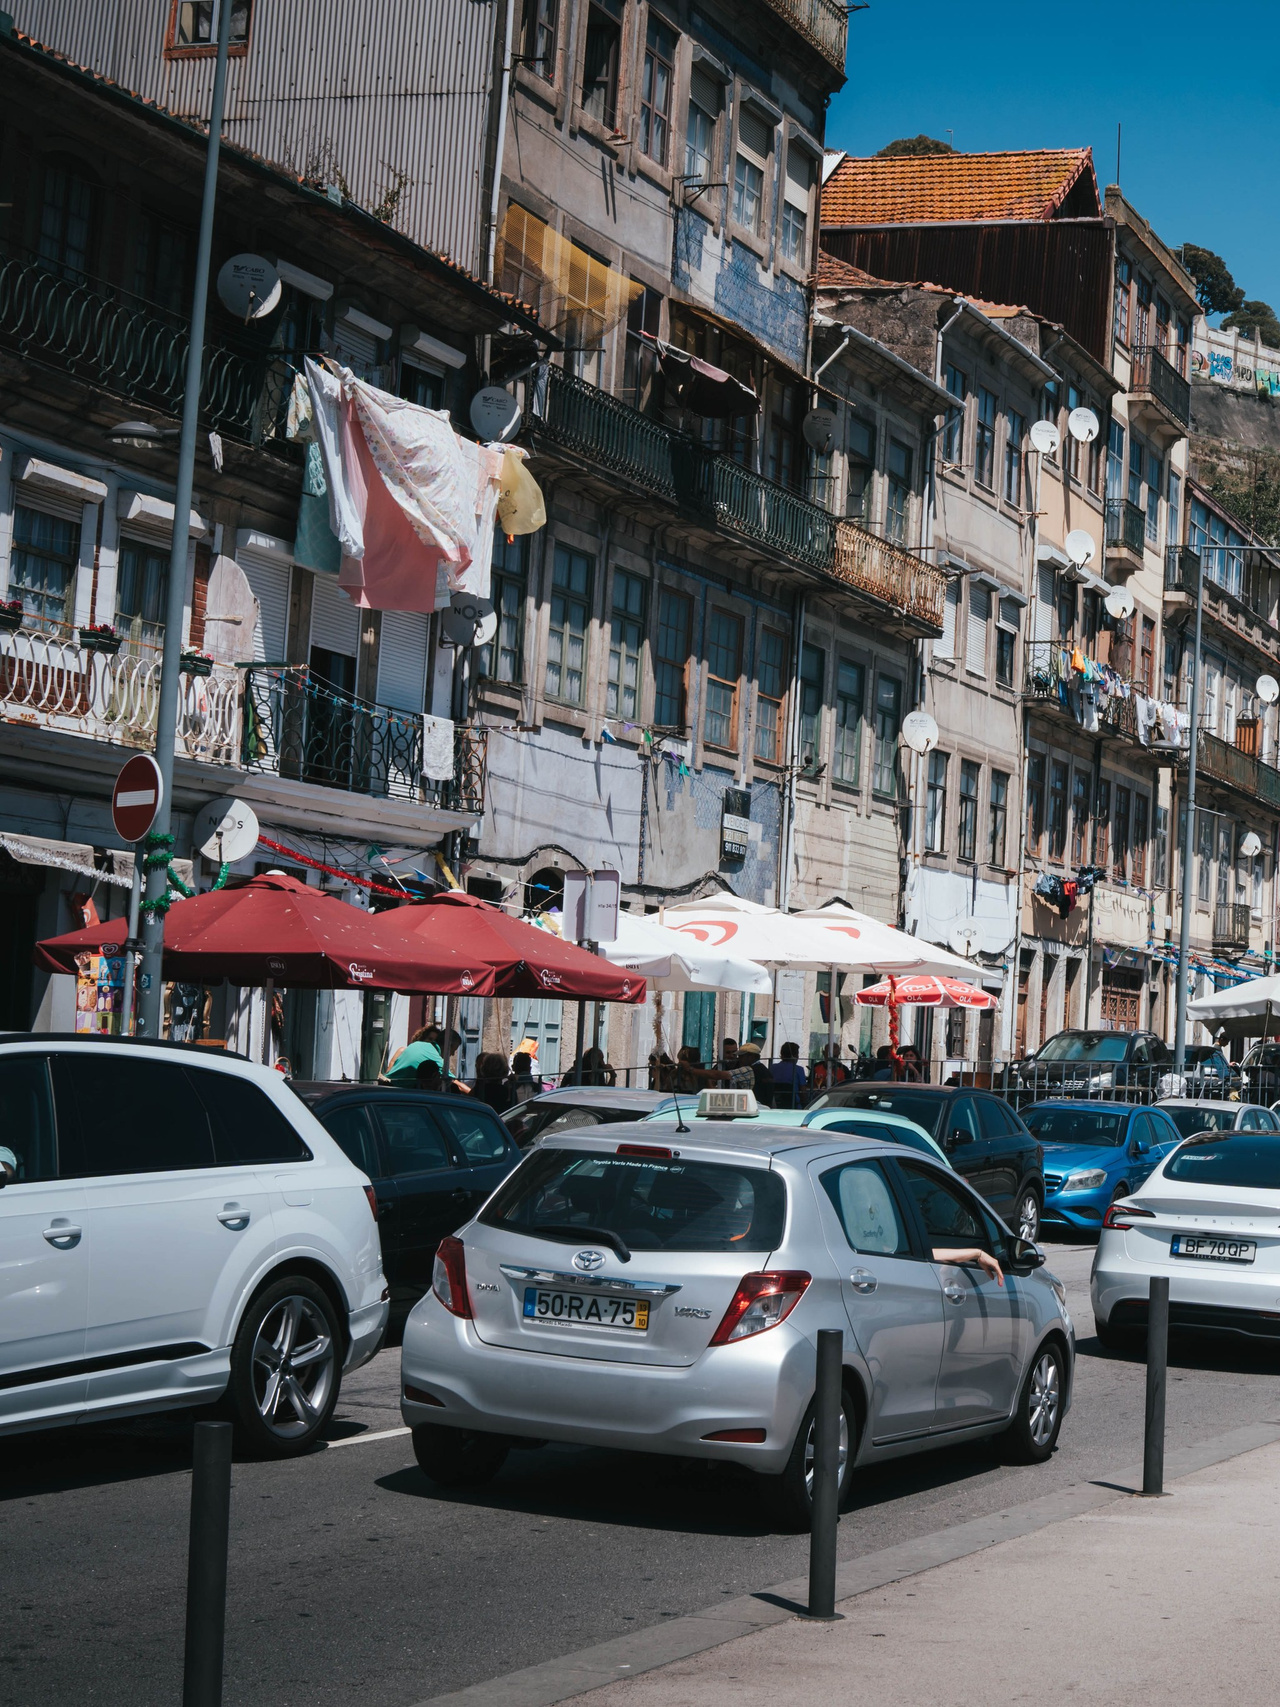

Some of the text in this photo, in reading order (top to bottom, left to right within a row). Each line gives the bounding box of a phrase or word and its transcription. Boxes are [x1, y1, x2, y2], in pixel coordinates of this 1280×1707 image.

[454, 605, 483, 620] NOS
[208, 814, 244, 832] NOS
[957, 928, 977, 938] NOS
[959, 995, 972, 1004] OLÁ
[711, 1094, 734, 1106] TAXI
[1177, 1216, 1253, 1226] TESLA
[1185, 1239, 1207, 1253] BF
[1209, 1241, 1226, 1255] 70
[1228, 1243, 1249, 1257] QP
